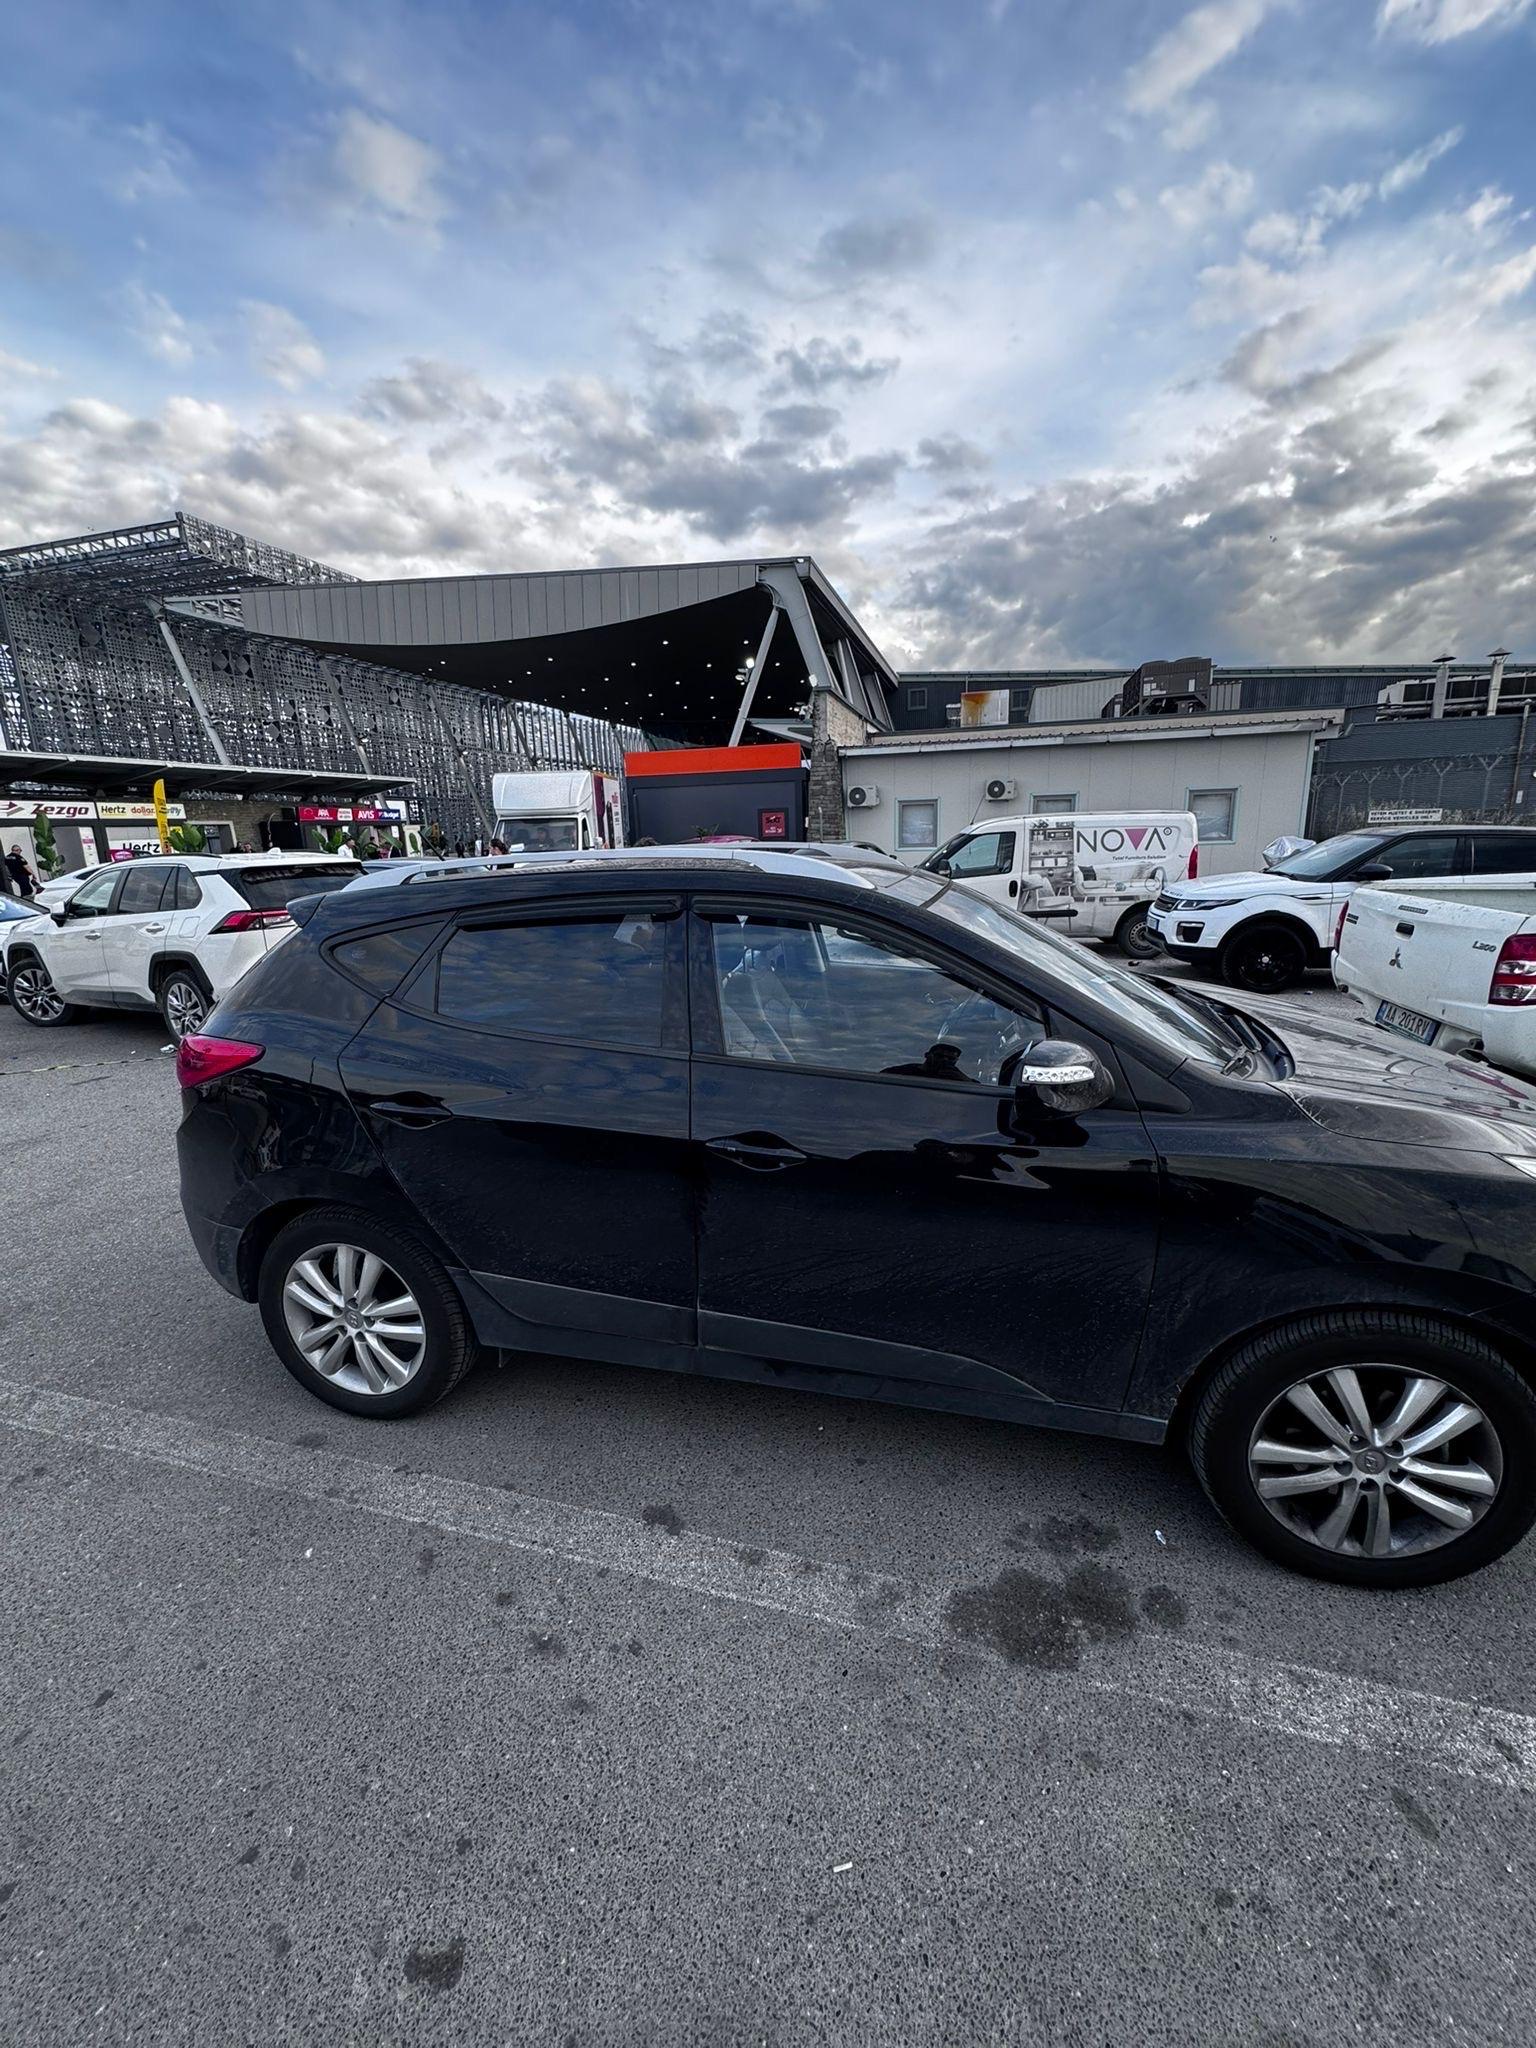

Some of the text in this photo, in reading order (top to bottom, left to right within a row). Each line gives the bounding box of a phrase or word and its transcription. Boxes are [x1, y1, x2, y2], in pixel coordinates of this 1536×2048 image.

[31, 803, 89, 818] Zezgo
[101, 805, 126, 814] Hertz
[358, 810, 375, 819] AVIS
[1386, 1006, 1398, 1023] AA
